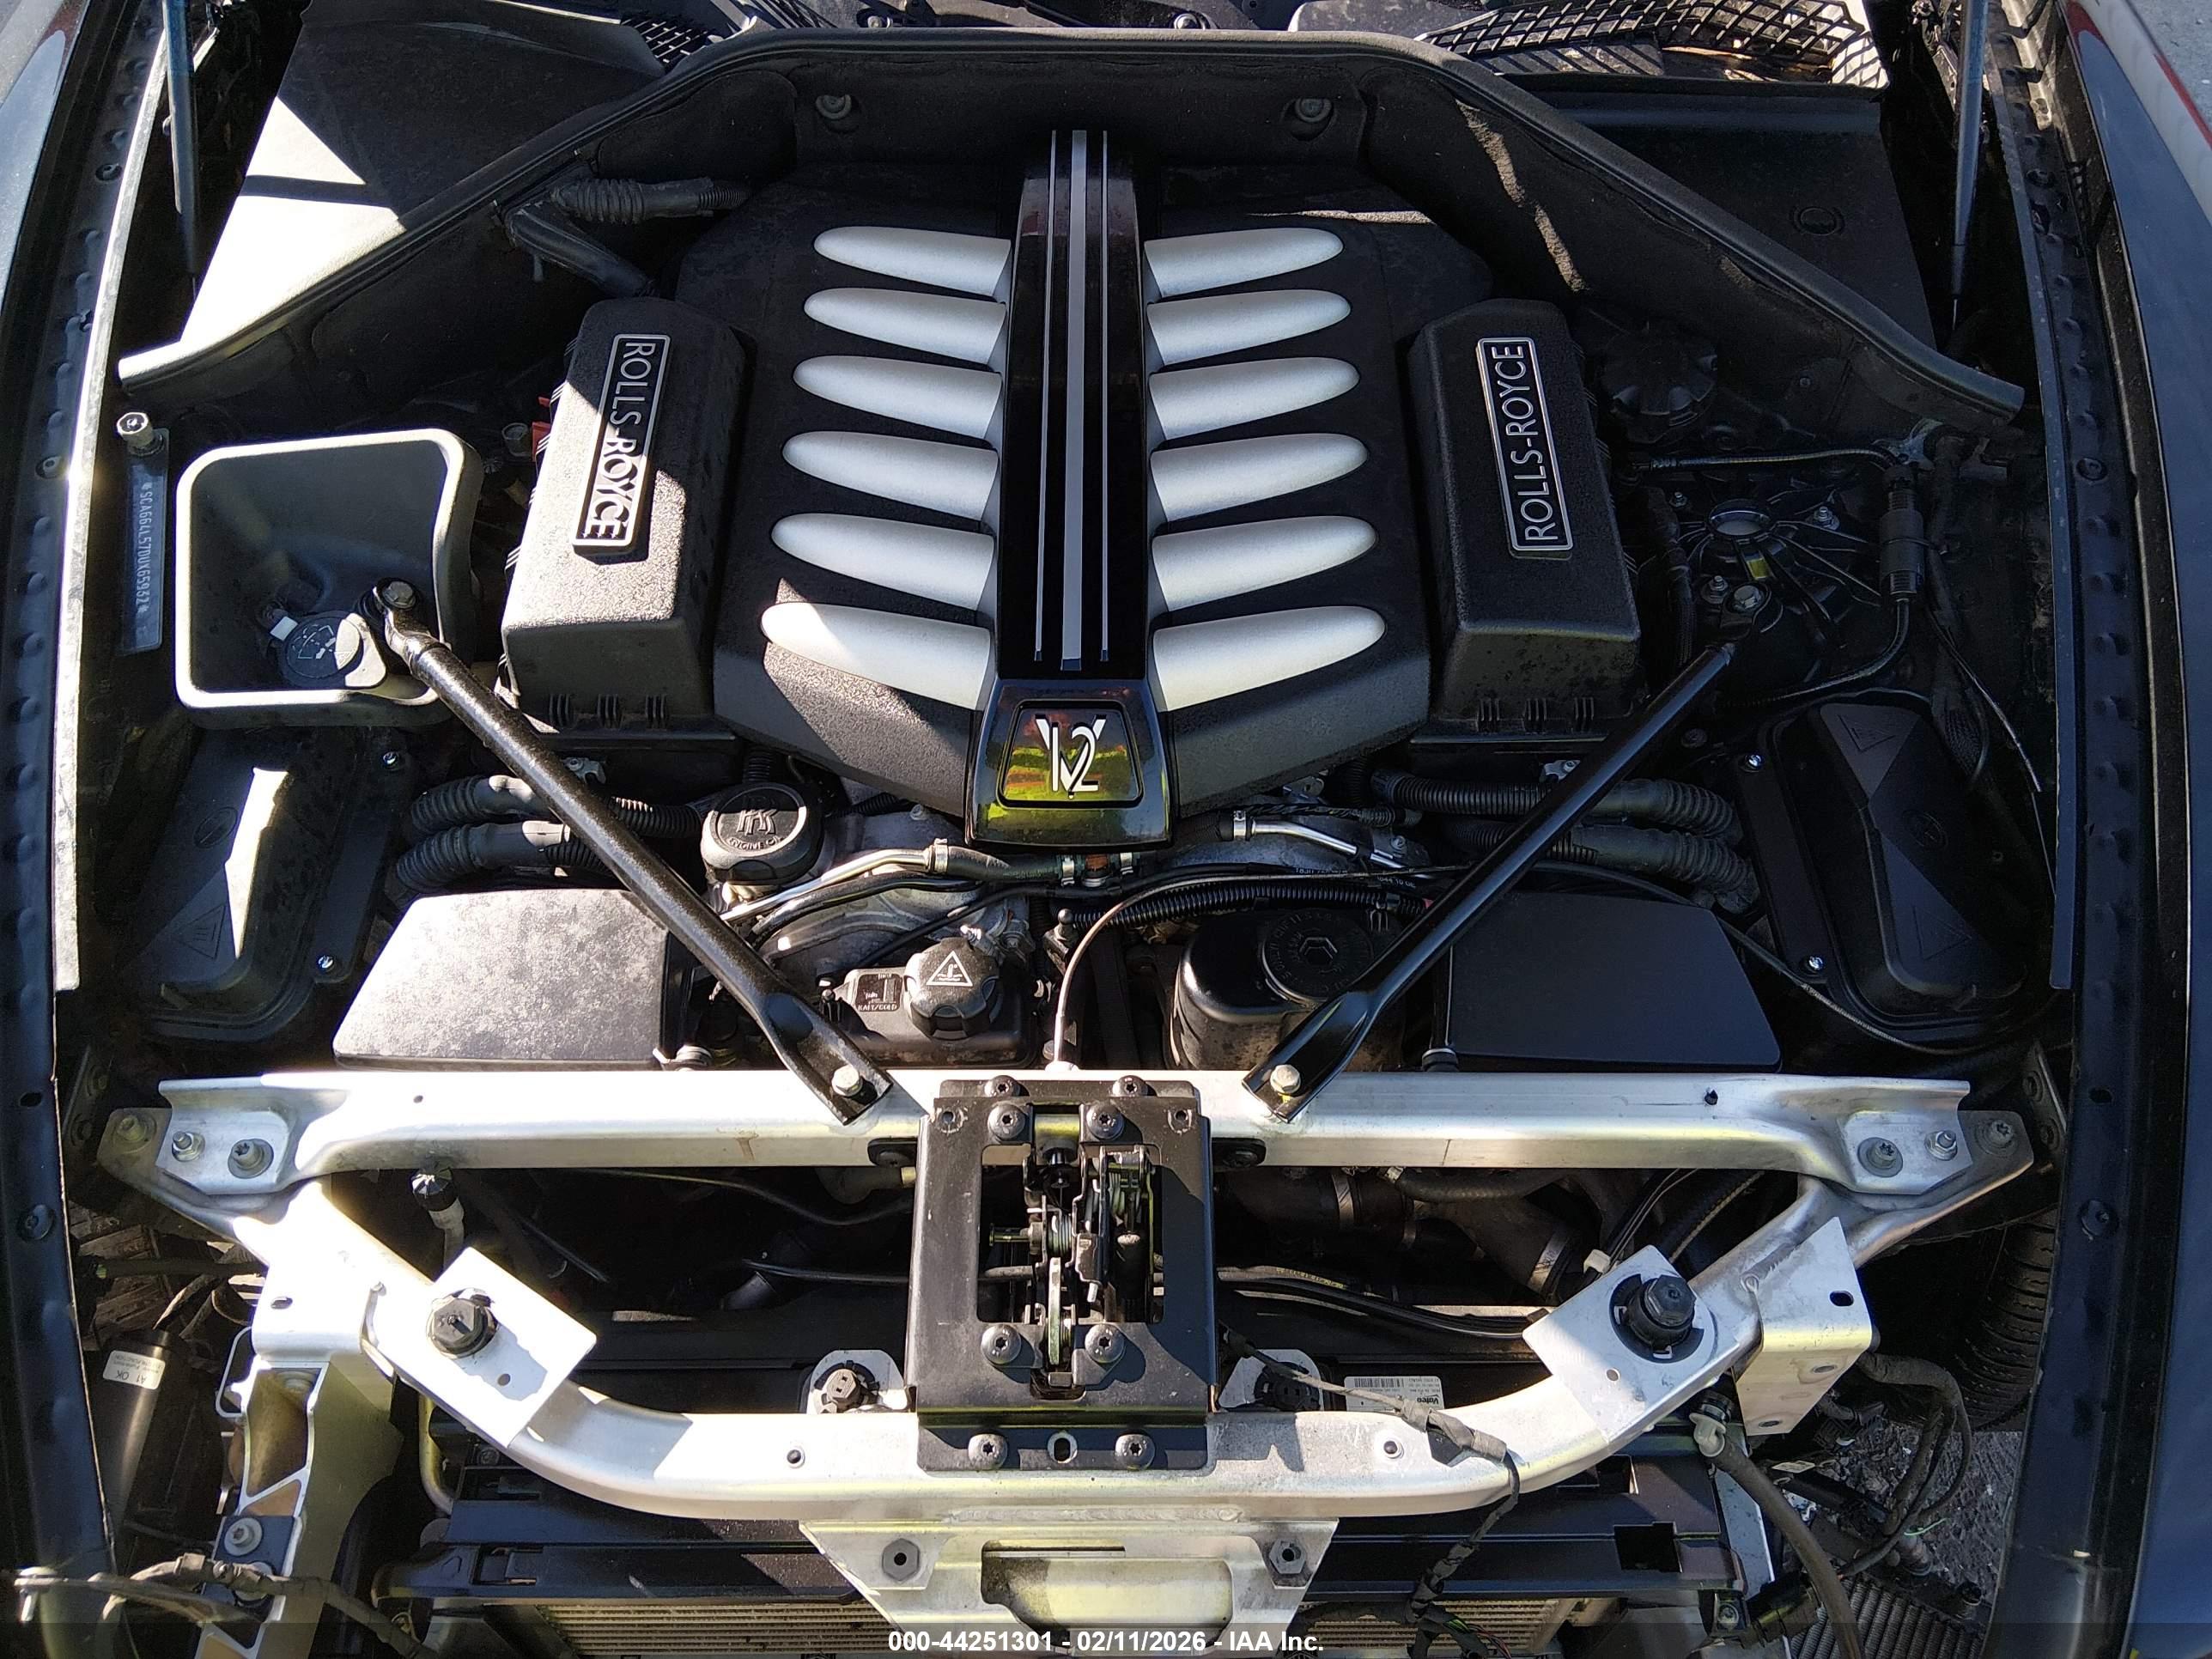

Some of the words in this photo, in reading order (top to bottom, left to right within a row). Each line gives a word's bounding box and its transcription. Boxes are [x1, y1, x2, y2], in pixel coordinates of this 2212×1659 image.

[581, 342, 656, 539] ROLLS-ROYCE
[1491, 345, 1559, 540] ROLLS-ROYCE
[117, 1370, 129, 1381] OK
